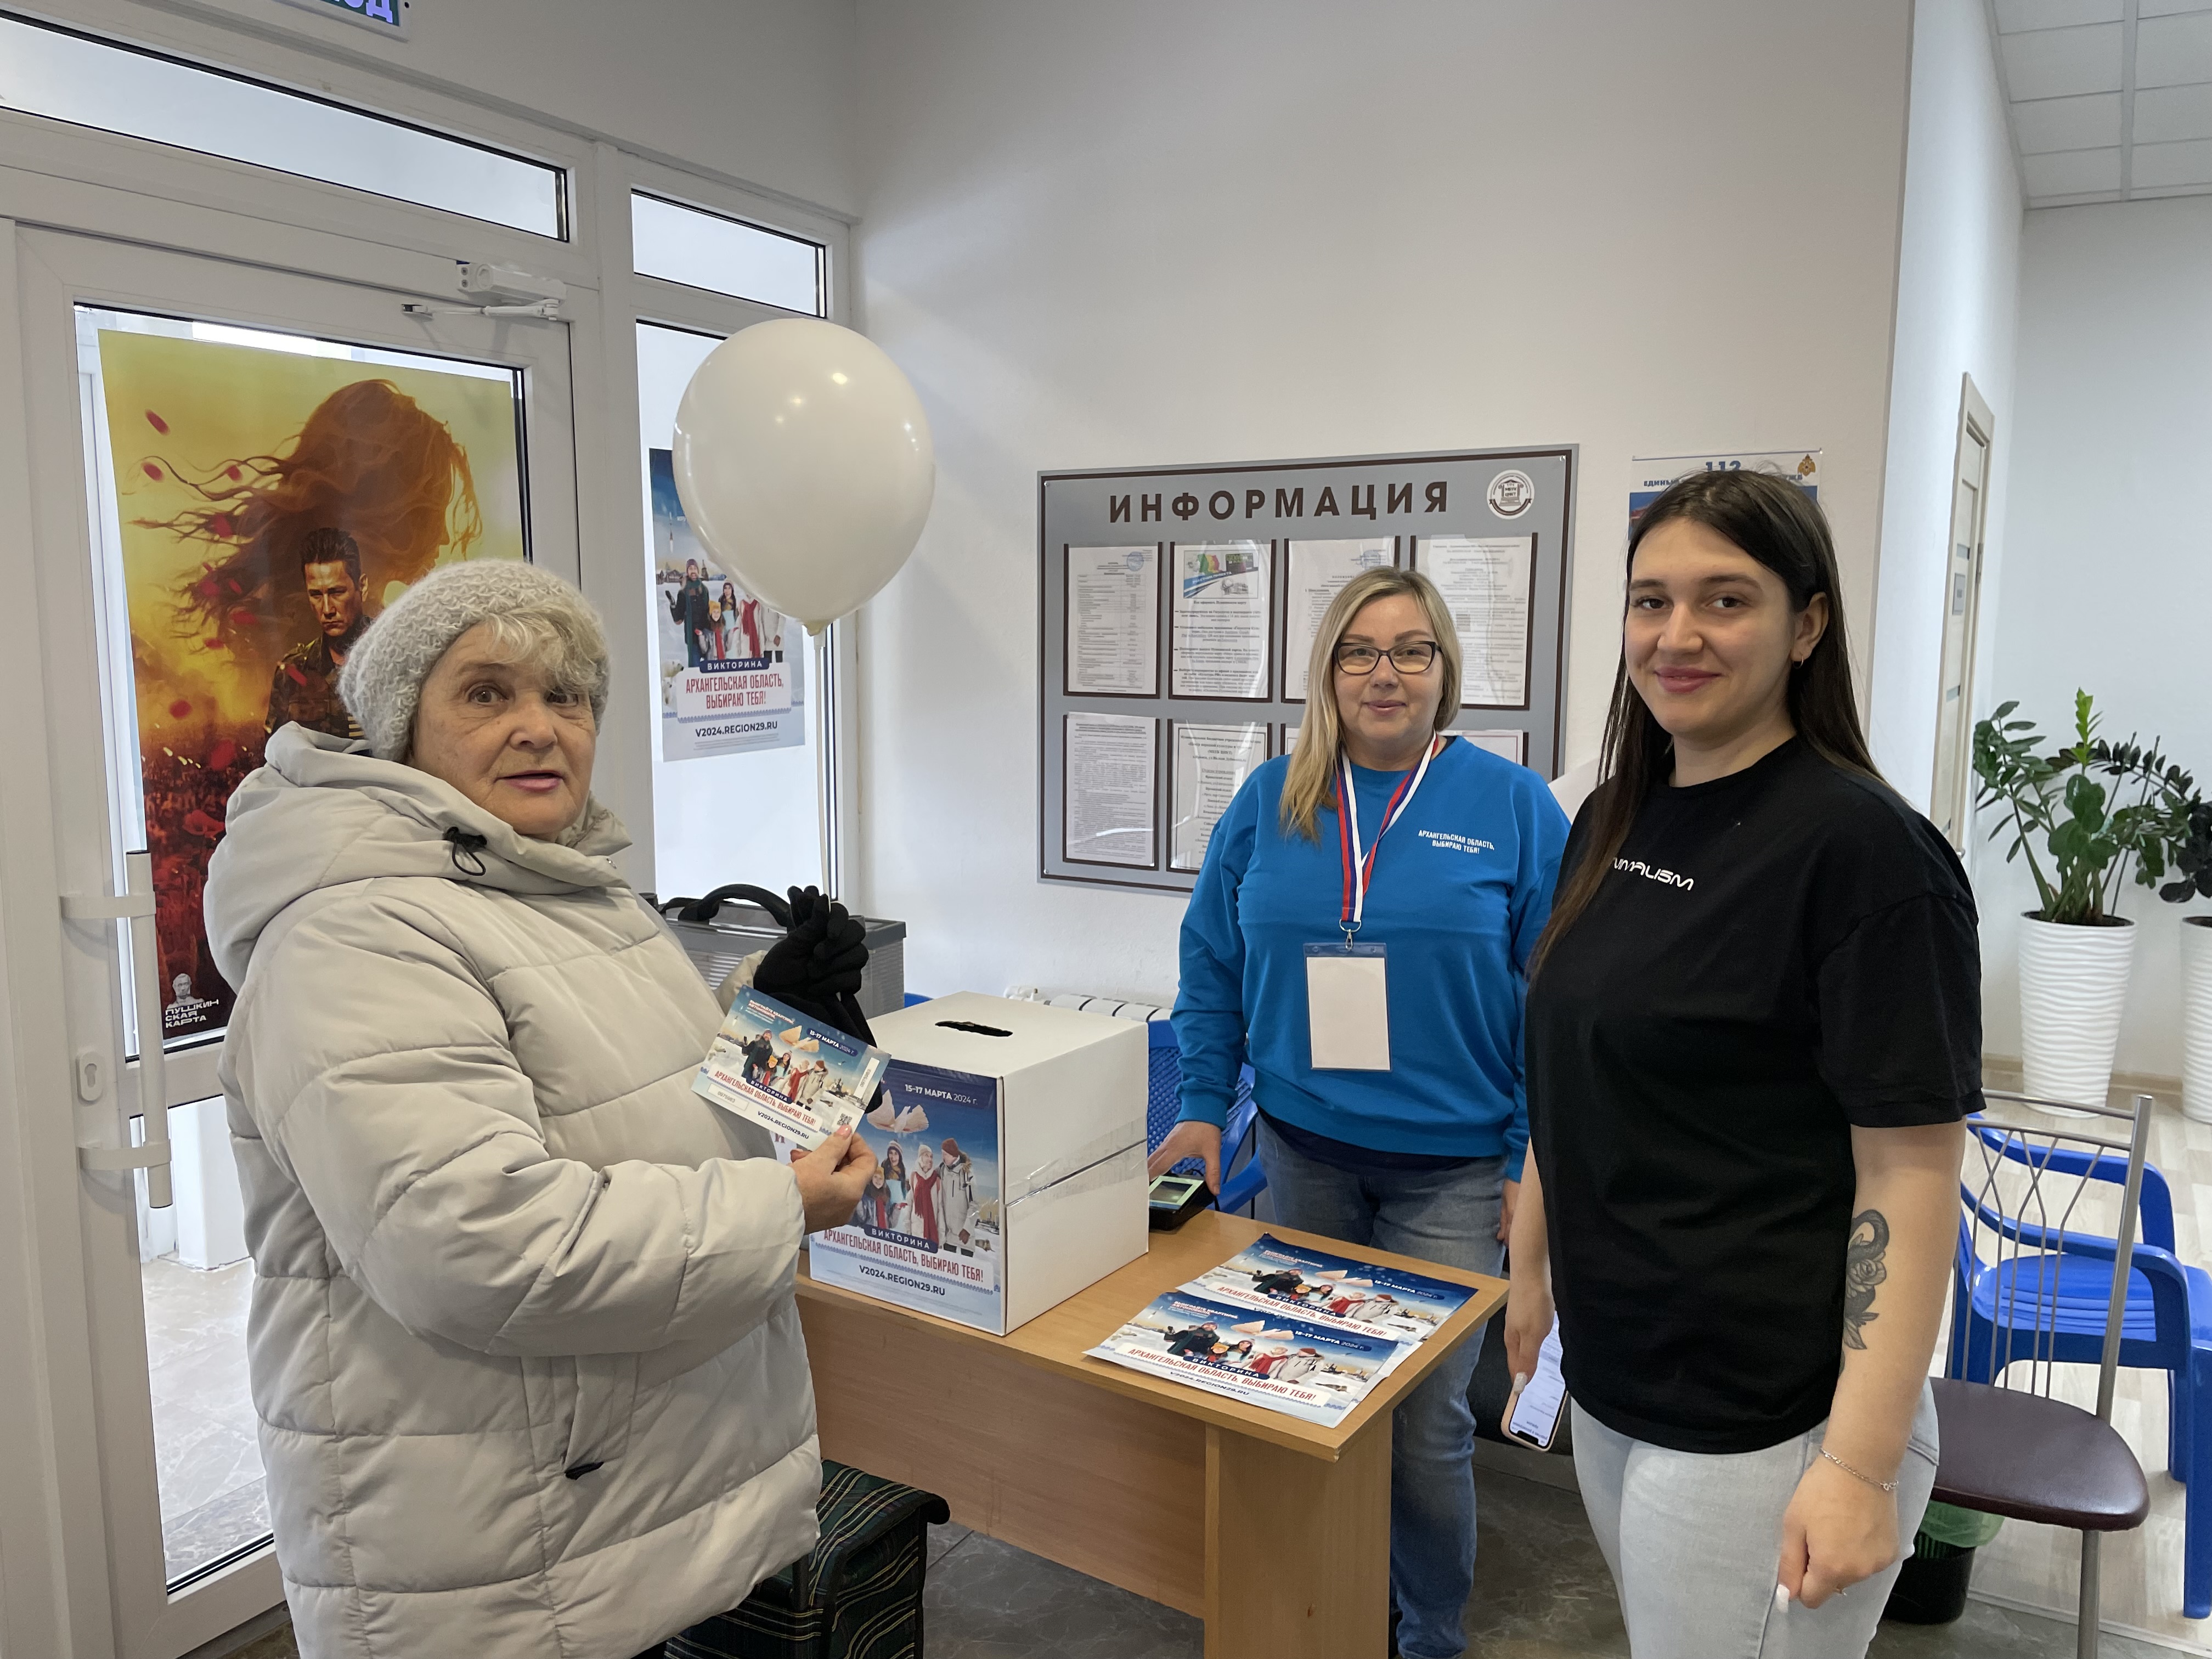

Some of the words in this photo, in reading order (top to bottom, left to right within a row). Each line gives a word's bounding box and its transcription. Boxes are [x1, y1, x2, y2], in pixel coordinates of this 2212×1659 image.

[1110, 481, 1447, 523] ИНФОРМАЦИЯ
[707, 660, 763, 671] ВИКТОРИНА
[686, 675, 747, 694] АРХАНГЕЛЬСКАЯ
[750, 673, 784, 689] ОБЛАСТЬ,
[706, 692, 744, 709] ВЫБИРАЮ
[747, 691, 766, 706] ТЕБЯ!
[695, 721, 778, 737] V2024.REGION29.RU
[1418, 830, 1466, 844] АРХАНГЕЛЬСКАЯ
[1467, 838, 1495, 851] ОБЛАСТЬ,
[1432, 840, 1462, 851] ВЫБИРАЮ
[1463, 845, 1480, 854] ТЕБЯ!
[165, 999, 219, 1015] ПУШКИН
[165, 1011, 198, 1022] СКАЯ
[165, 1015, 207, 1028] КАРТА
[810, 1029, 822, 1039] 15-17
[822, 1036, 839, 1048] МАРТА
[714, 1070, 754, 1095] АРХАНГЕЛЬСКАЯ
[754, 1090, 776, 1107] ОБЛАСТЬ,
[777, 1102, 802, 1119] ВЫБИРАЮ
[802, 1113, 816, 1125] ТЕБЯ!
[751, 1080, 788, 1102] ВИКТОРИНА
[905, 1084, 923, 1094] 15-17
[924, 1087, 952, 1100] МАРТА
[953, 1093, 971, 1104] 2024
[758, 1110, 809, 1139] V2024.REGION29.RU
[872, 1228, 930, 1250] ВИКТОРИНА
[823, 1229, 882, 1255] АРХАНГЕЛЬСКАЯ
[884, 1244, 919, 1267] ОБЛАСТЬ,
[921, 1254, 959, 1276] ВЫБИРАЮ
[961, 1264, 984, 1283] ТЕБЯ!
[859, 1265, 945, 1296] V2024.REGION29.RU
[1391, 1284, 1415, 1293] МАРТА
[1217, 1286, 1280, 1307] АРХАНГЕЛЬСКАЯ
[1317, 1314, 1362, 1330] ВЫБИРАЮ
[1362, 1325, 1387, 1337] ТЕБЯ!
[1276, 1295, 1336, 1316] ВИКТОРИНА
[1313, 1335, 1340, 1345] МАРТА
[1128, 1348, 1199, 1371] АРХАНГЕЛЬСКАЯ
[1198, 1366, 1238, 1383] ОБЛАСТЬ,
[1242, 1377, 1289, 1394] ВЫБИРАЮ
[1289, 1390, 1317, 1402] ТЕБЯ!
[1192, 1357, 1260, 1378] ВИКТОРИНА
[1170, 1372, 1250, 1396] V2024.REGION29.RU
